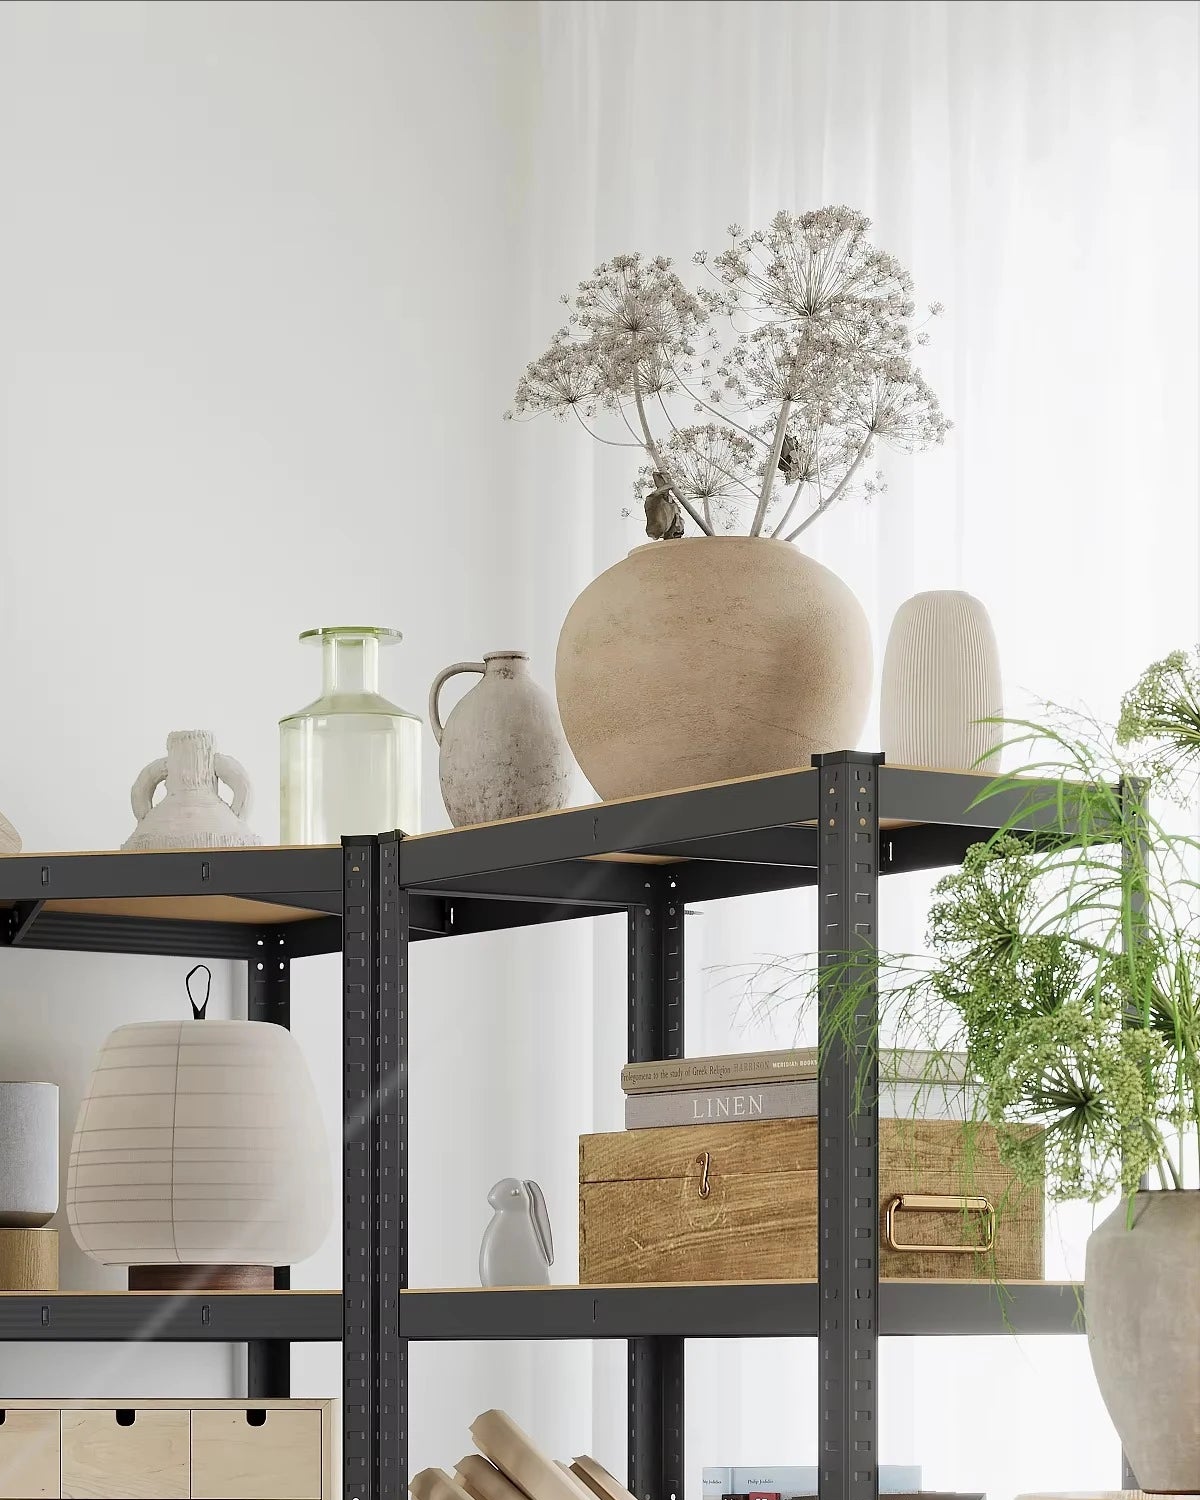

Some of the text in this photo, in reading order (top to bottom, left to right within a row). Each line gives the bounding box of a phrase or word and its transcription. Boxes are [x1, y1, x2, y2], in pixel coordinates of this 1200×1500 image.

[653, 1072, 659, 1080] to
[660, 1069, 669, 1079] the
[669, 1067, 682, 1080] study
[684, 1066, 691, 1076] of
[692, 1066, 708, 1076] Greek
[709, 1065, 731, 1079] Religion
[692, 1094, 764, 1118] LINEN
